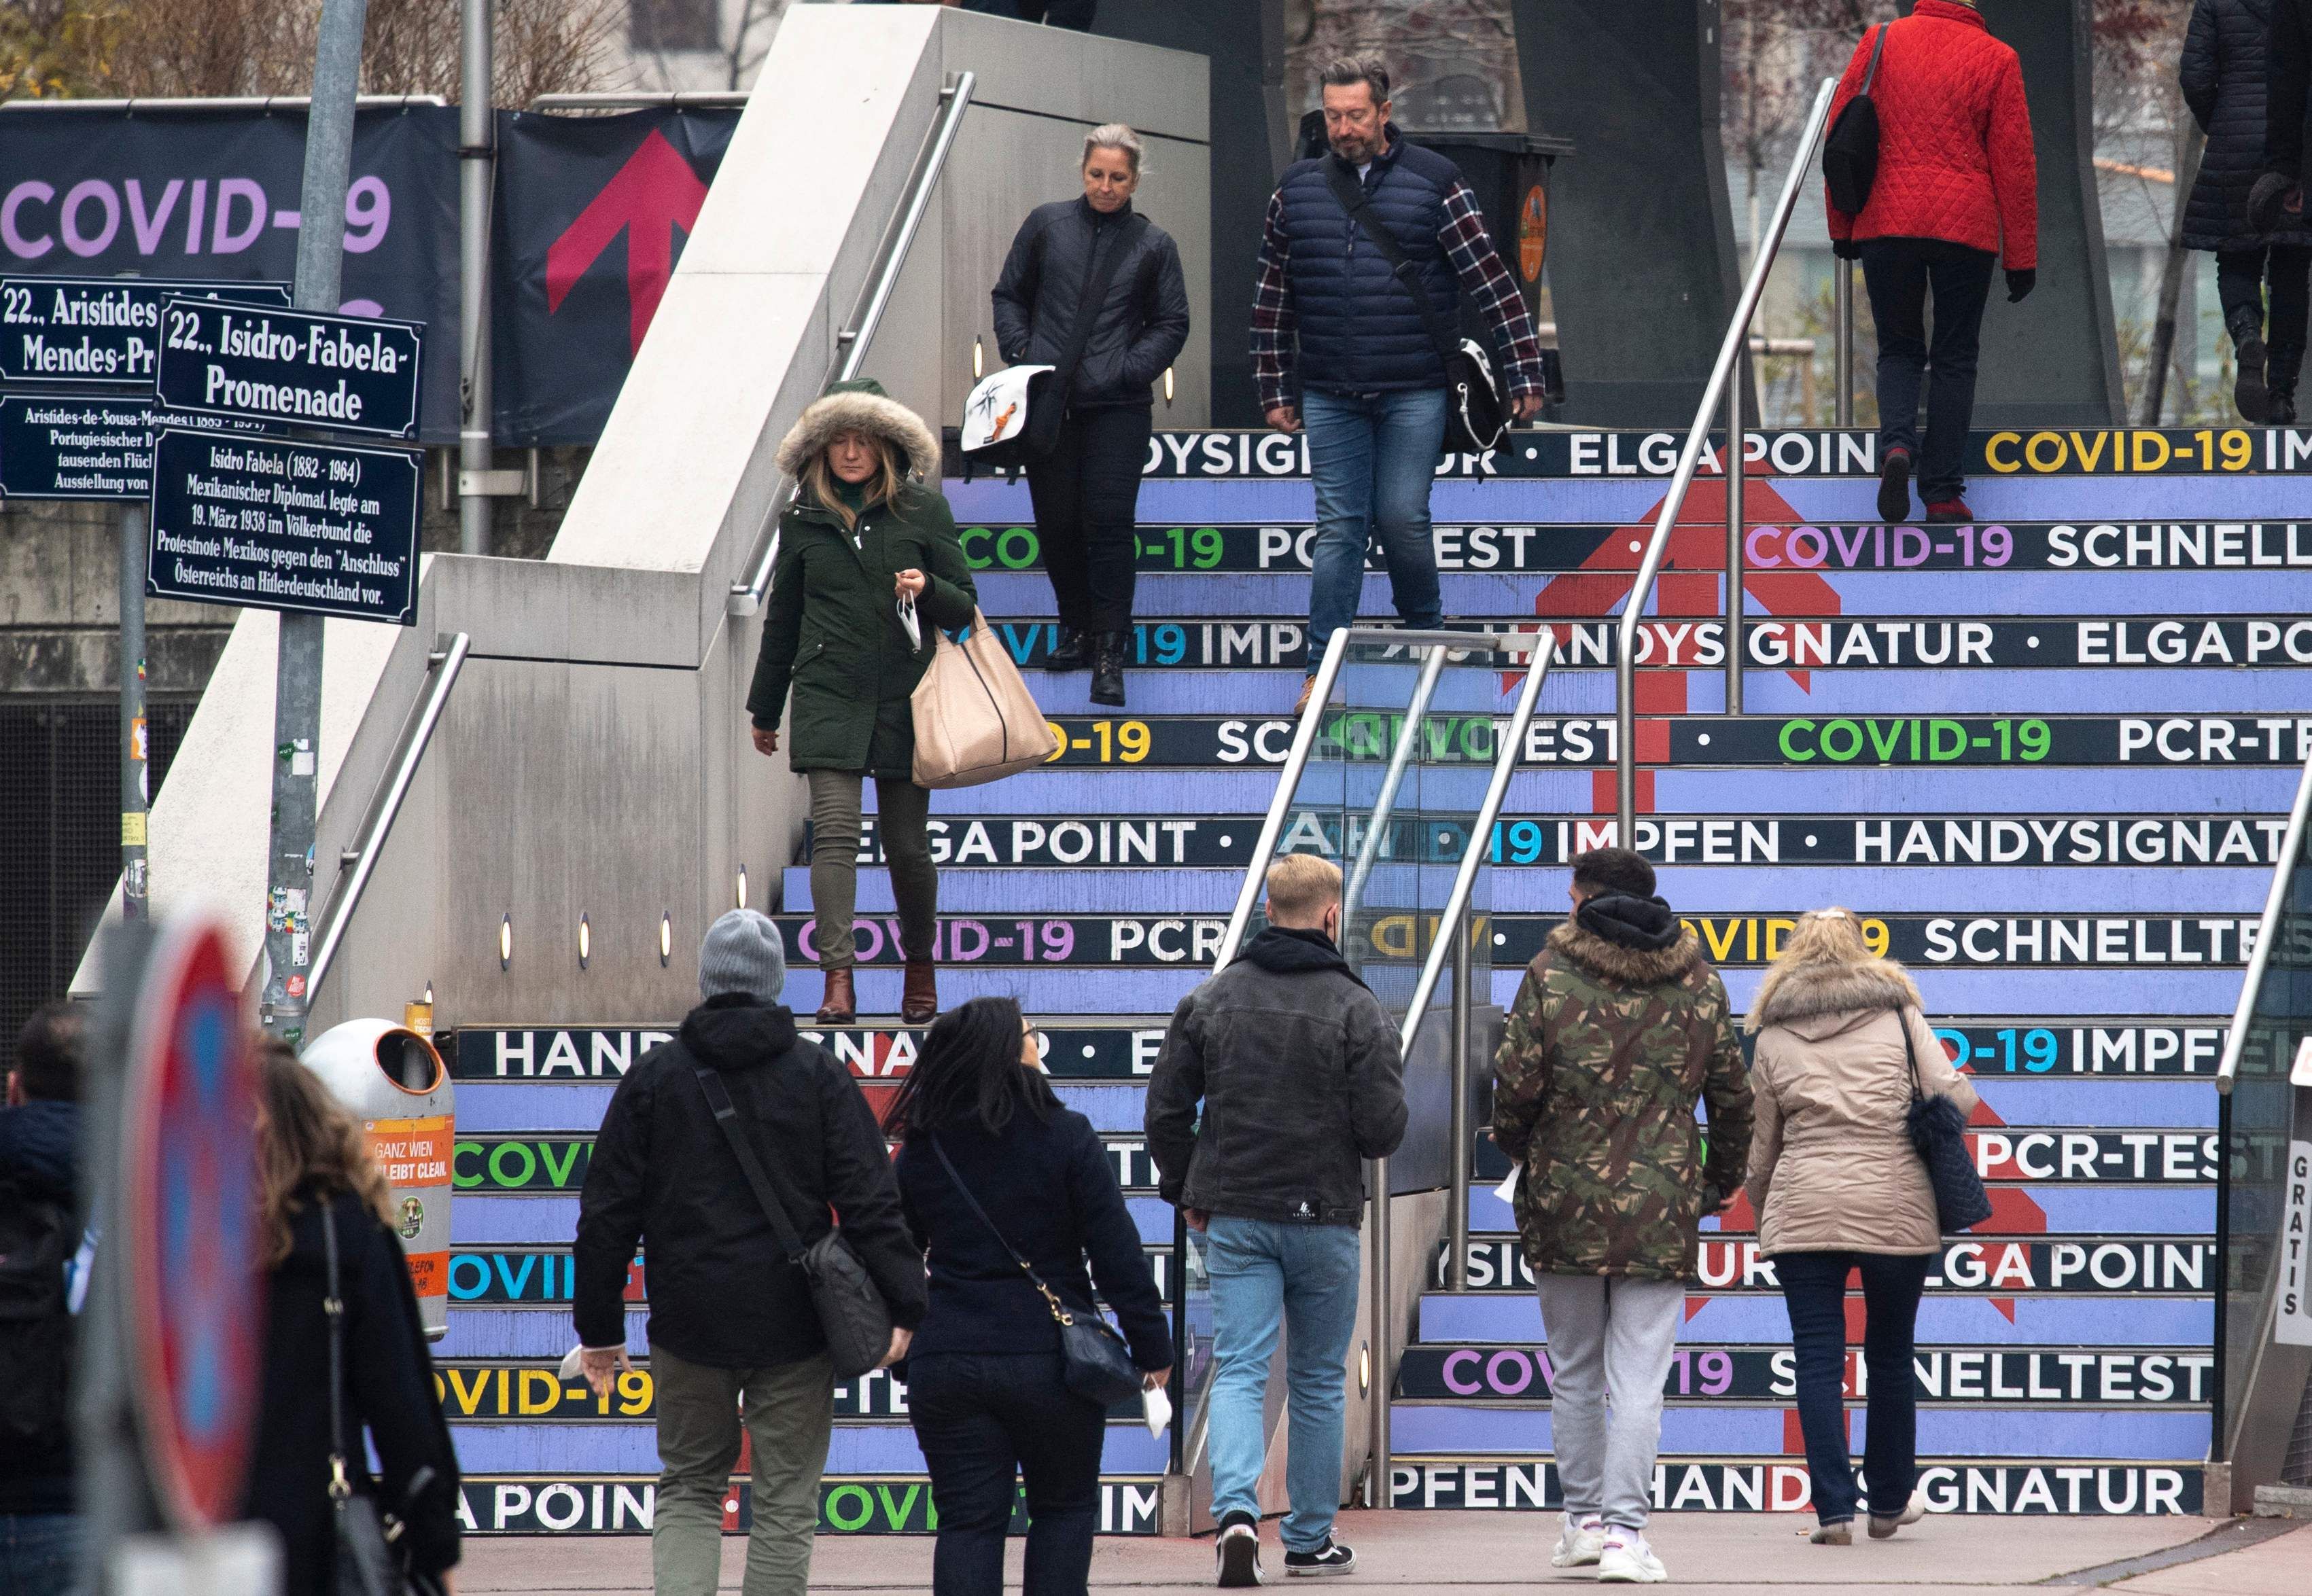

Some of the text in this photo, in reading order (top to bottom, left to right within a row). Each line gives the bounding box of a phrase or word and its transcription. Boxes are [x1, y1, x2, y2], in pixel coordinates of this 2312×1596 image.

[0, 176, 391, 260] COVID-9
[4, 288, 157, 327] 22., Aristides
[23, 334, 156, 374] Mendes-Pr
[168, 311, 408, 374] 22., Isidro-Fabela-
[205, 364, 362, 421] Promenade
[50, 429, 153, 448] Portugiesischer D
[1744, 433, 1875, 474] POIN
[1986, 430, 2252, 473] COVID-19
[58, 453, 121, 469] tausenden
[210, 446, 243, 471] Isidro
[245, 449, 283, 475] Fabela
[287, 450, 318, 481] (1882
[329, 457, 361, 488] 1964)
[54, 473, 148, 493] Ausstellung von
[186, 474, 379, 516] Mexikanischer Diplomat, legte am
[192, 503, 372, 544] 19. März 1938 im Völkerbund die
[156, 529, 406, 578] Protestnote Mexikos gegen den "Anschluss"
[1746, 526, 2013, 567] COVID-19
[2046, 525, 2312, 567] SCHNELL
[175, 557, 384, 605] Österreichs an Hitlerdeutschland vor.
[2078, 622, 2233, 663] ELGA
[1779, 719, 2051, 762] COVID-19
[1013, 821, 1196, 863] POINT
[1856, 820, 2288, 863] HANDYSIGNAT
[1111, 919, 1227, 961] PCR
[375, 1141, 433, 1158] GANZ WIEN
[417, 1161, 446, 1179] CLEAN.
[2284, 1156, 2307, 1315] GRATIS
[495, 1484, 654, 1529] POIN
[1390, 1464, 1545, 1508] PFEN
